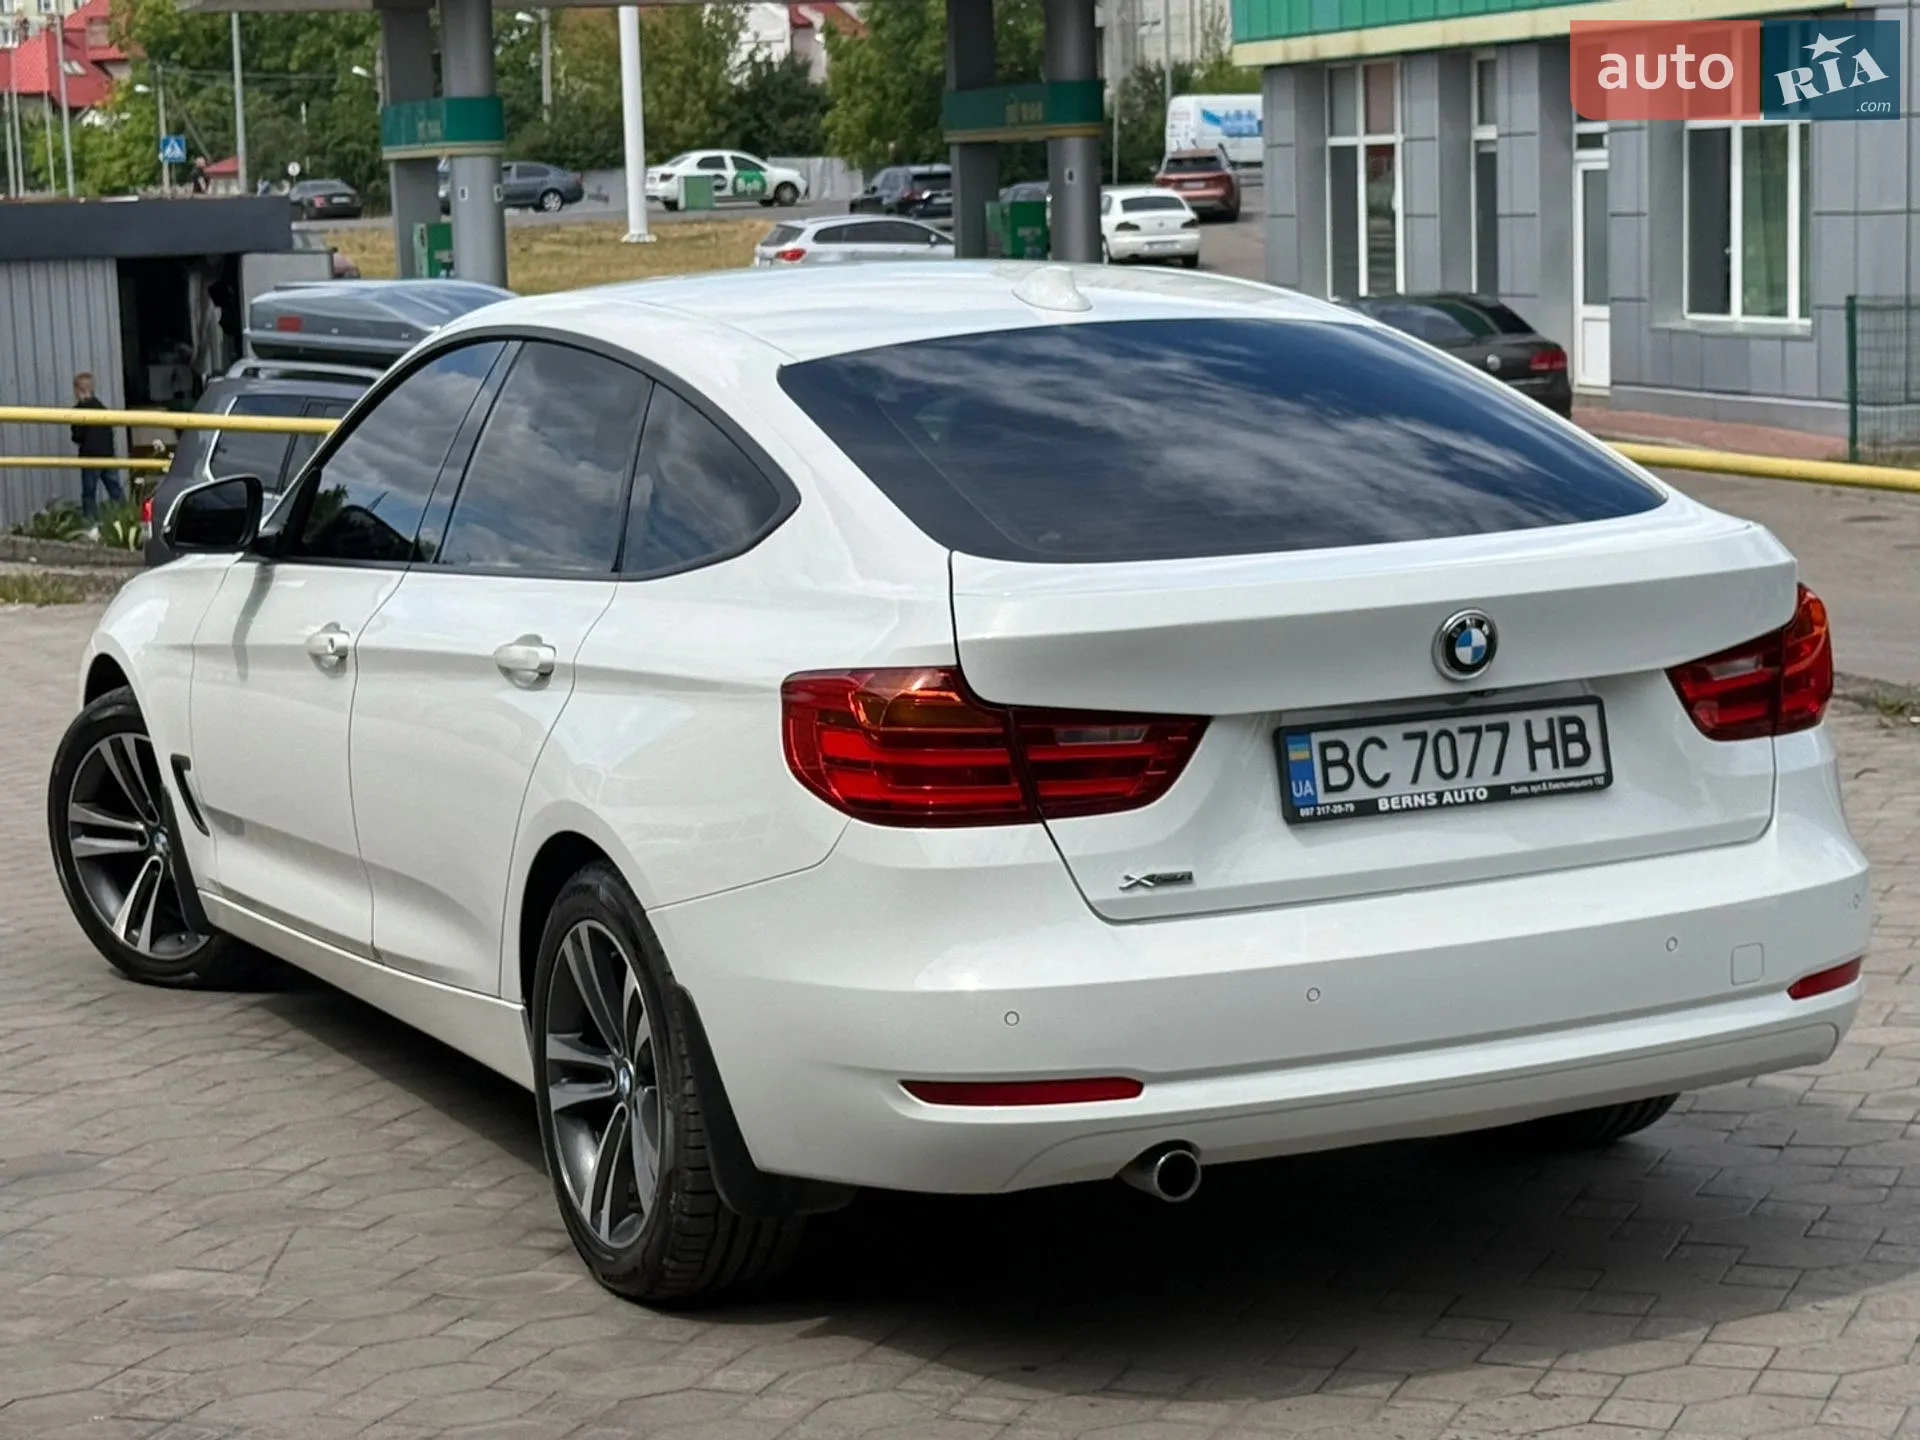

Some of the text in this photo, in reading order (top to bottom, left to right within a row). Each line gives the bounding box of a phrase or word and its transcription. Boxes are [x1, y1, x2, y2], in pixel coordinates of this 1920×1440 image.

[1319, 715, 1591, 794] BC 7077 HB
[1291, 779, 1315, 798] UA
[1377, 787, 1488, 812] BERNS AUTO
